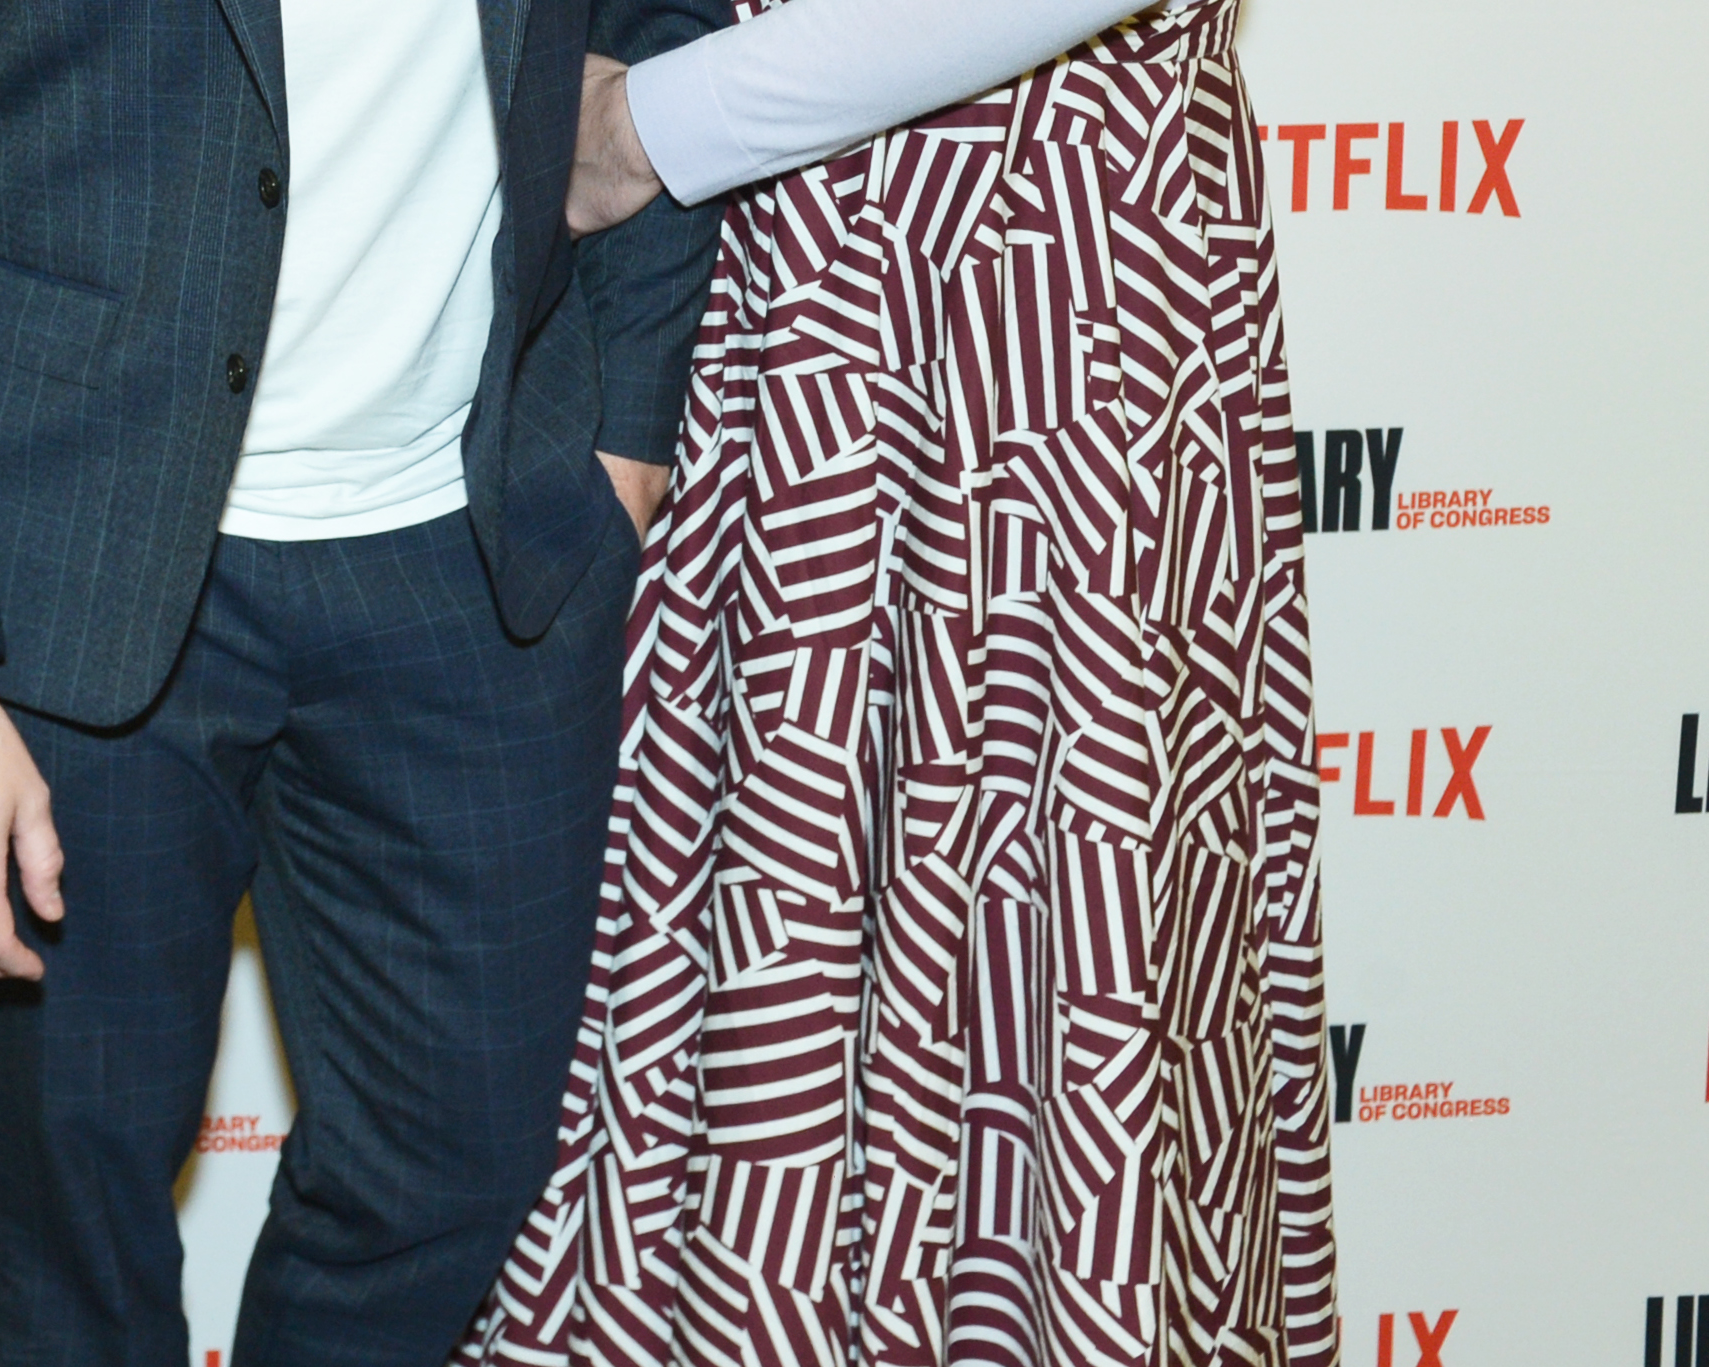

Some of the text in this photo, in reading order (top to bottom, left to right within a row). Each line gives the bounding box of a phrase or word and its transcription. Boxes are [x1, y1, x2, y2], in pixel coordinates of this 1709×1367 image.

[1256, 118, 1526, 218] TFLIX
[1397, 489, 1492, 511] LIBRARY
[1396, 507, 1551, 530] OF CONGRESS
[1359, 1082, 1453, 1104] LIBRARY
[1359, 1097, 1511, 1122] OF CONGRESS
